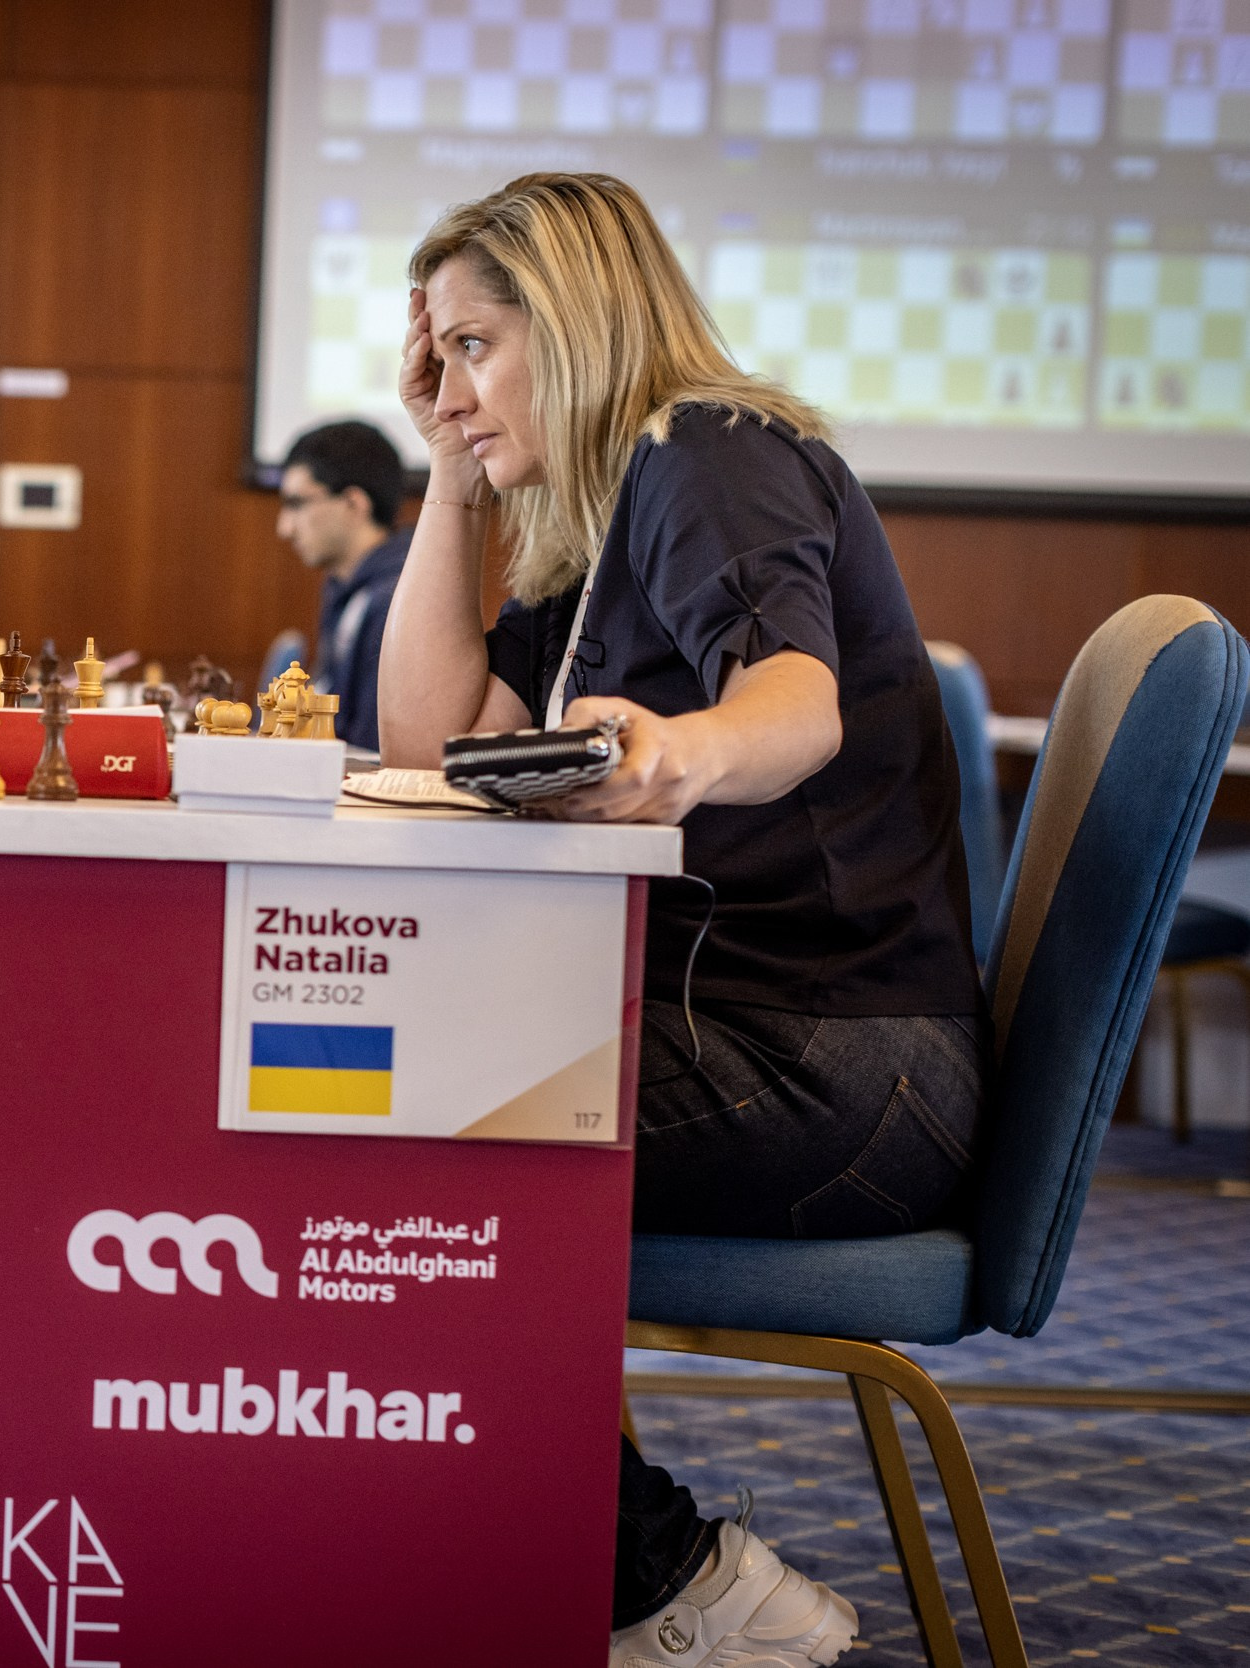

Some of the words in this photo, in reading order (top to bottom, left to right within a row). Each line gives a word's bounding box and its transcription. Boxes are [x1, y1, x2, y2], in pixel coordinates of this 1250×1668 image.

[255, 907, 419, 939] Zhukova
[255, 944, 388, 975] Natalia
[252, 981, 293, 1003] GM
[301, 983, 365, 1006] 2302
[573, 1112, 603, 1129] 117
[300, 1215, 370, 1242] موتورز
[372, 1216, 470, 1249] عبدالغني
[472, 1216, 500, 1246] آل
[299, 1247, 331, 1273] Al
[334, 1248, 497, 1283] Abdulghani
[298, 1274, 397, 1303] Motors
[92, 1367, 476, 1444] mubkhar.
